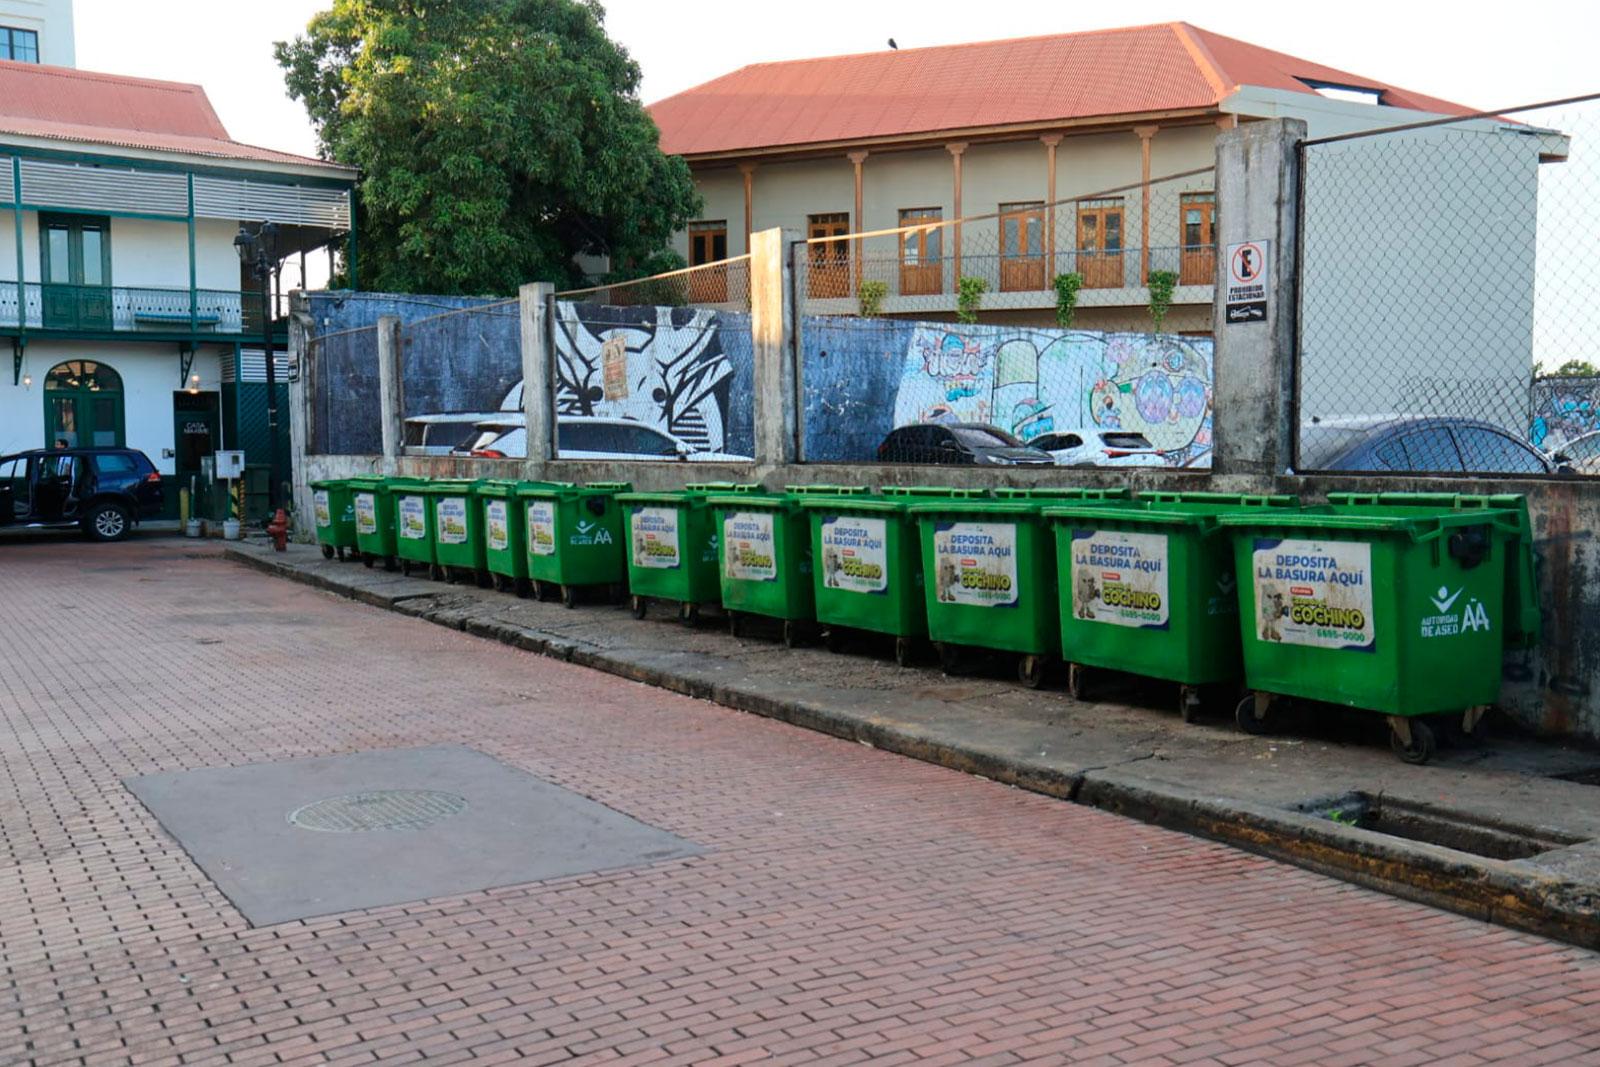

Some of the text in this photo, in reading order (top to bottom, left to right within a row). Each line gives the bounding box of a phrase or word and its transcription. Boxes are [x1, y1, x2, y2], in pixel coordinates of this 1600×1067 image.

[834, 527, 868, 537] DEPOSITA
[824, 535, 832, 544] LA
[834, 537, 861, 547] BASURA
[951, 535, 994, 545] DEPOSITA
[938, 544, 1011, 557] LA BASURA AQUÍ
[1090, 544, 1141, 557] DEPOSITA
[1076, 554, 1161, 573] LA BASURA AQUÍ
[1276, 555, 1337, 569] DEPOSITA
[961, 574, 1012, 591] COCHINO
[1258, 567, 1363, 586] LA BASURA AQUÍ
[1102, 588, 1161, 610] COCHINO
[1290, 604, 1365, 630] COCHINO
[1421, 614, 1458, 625] AUTORIDAD
[1421, 624, 1458, 637] DE ASEO
